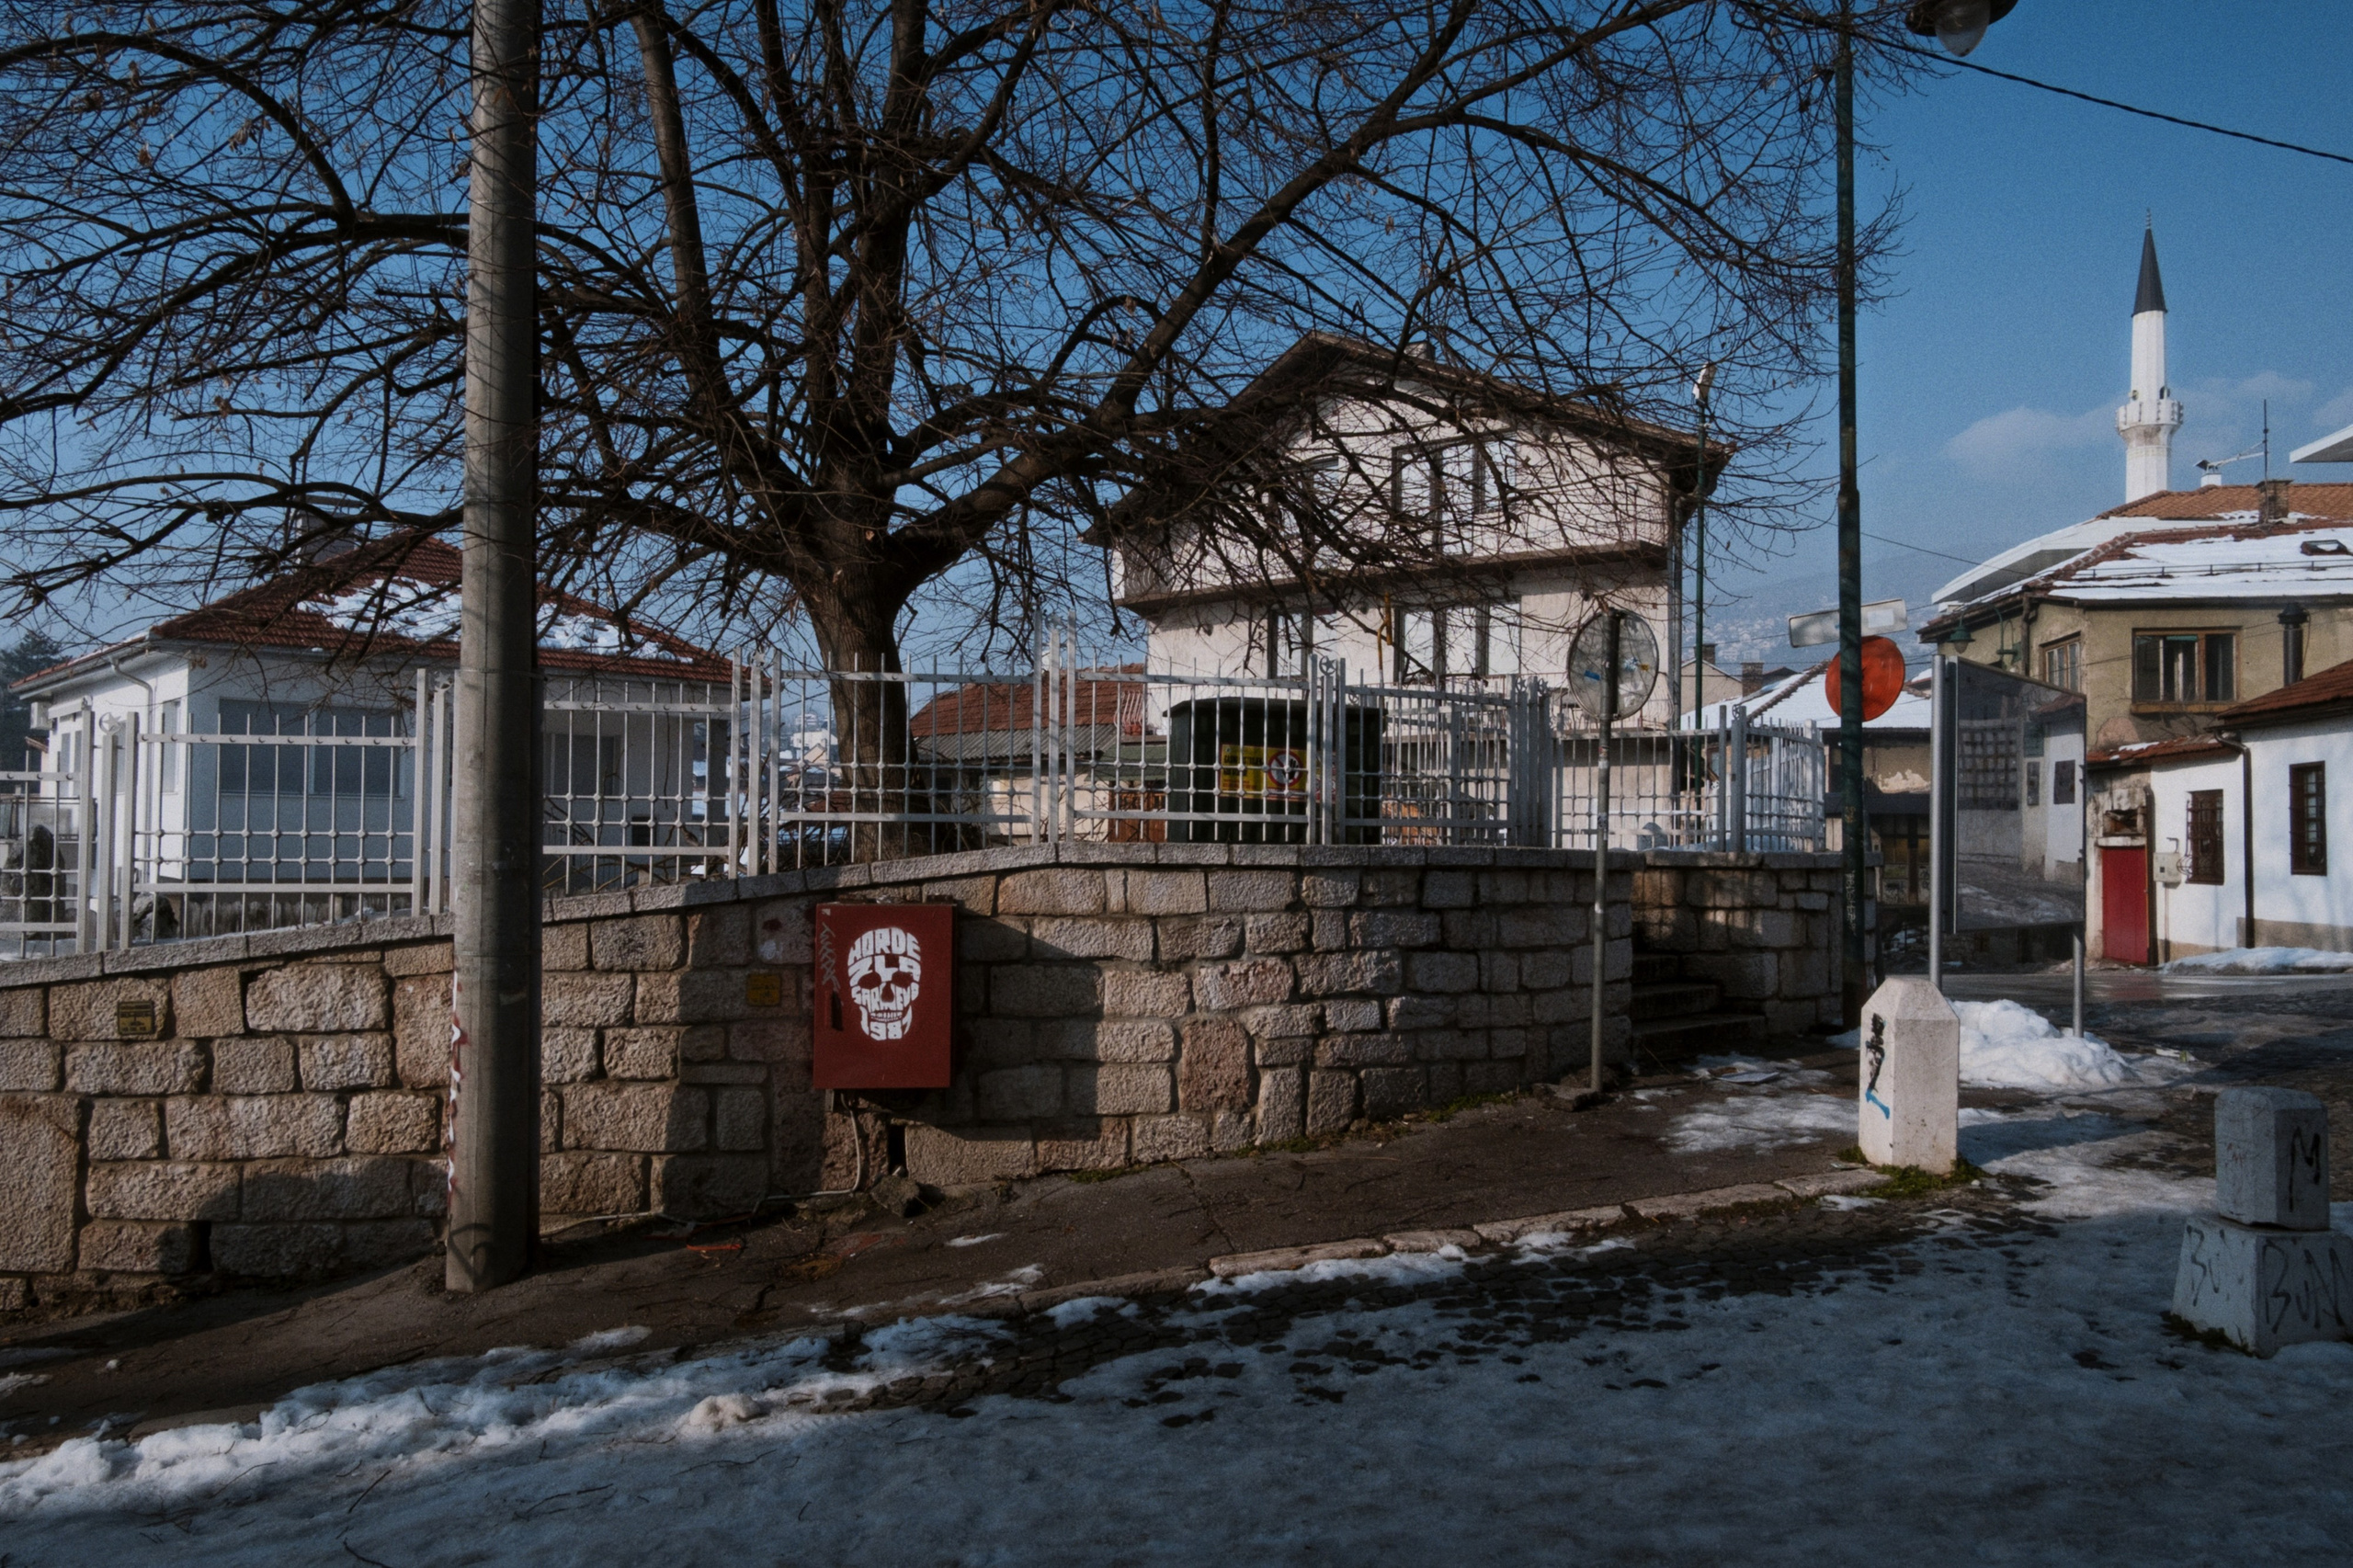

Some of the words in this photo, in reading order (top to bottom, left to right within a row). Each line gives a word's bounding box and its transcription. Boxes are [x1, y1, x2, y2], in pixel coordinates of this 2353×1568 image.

[847, 927, 921, 966] HORDE
[847, 955, 922, 987] ZLA
[859, 1006, 913, 1040] 1987
